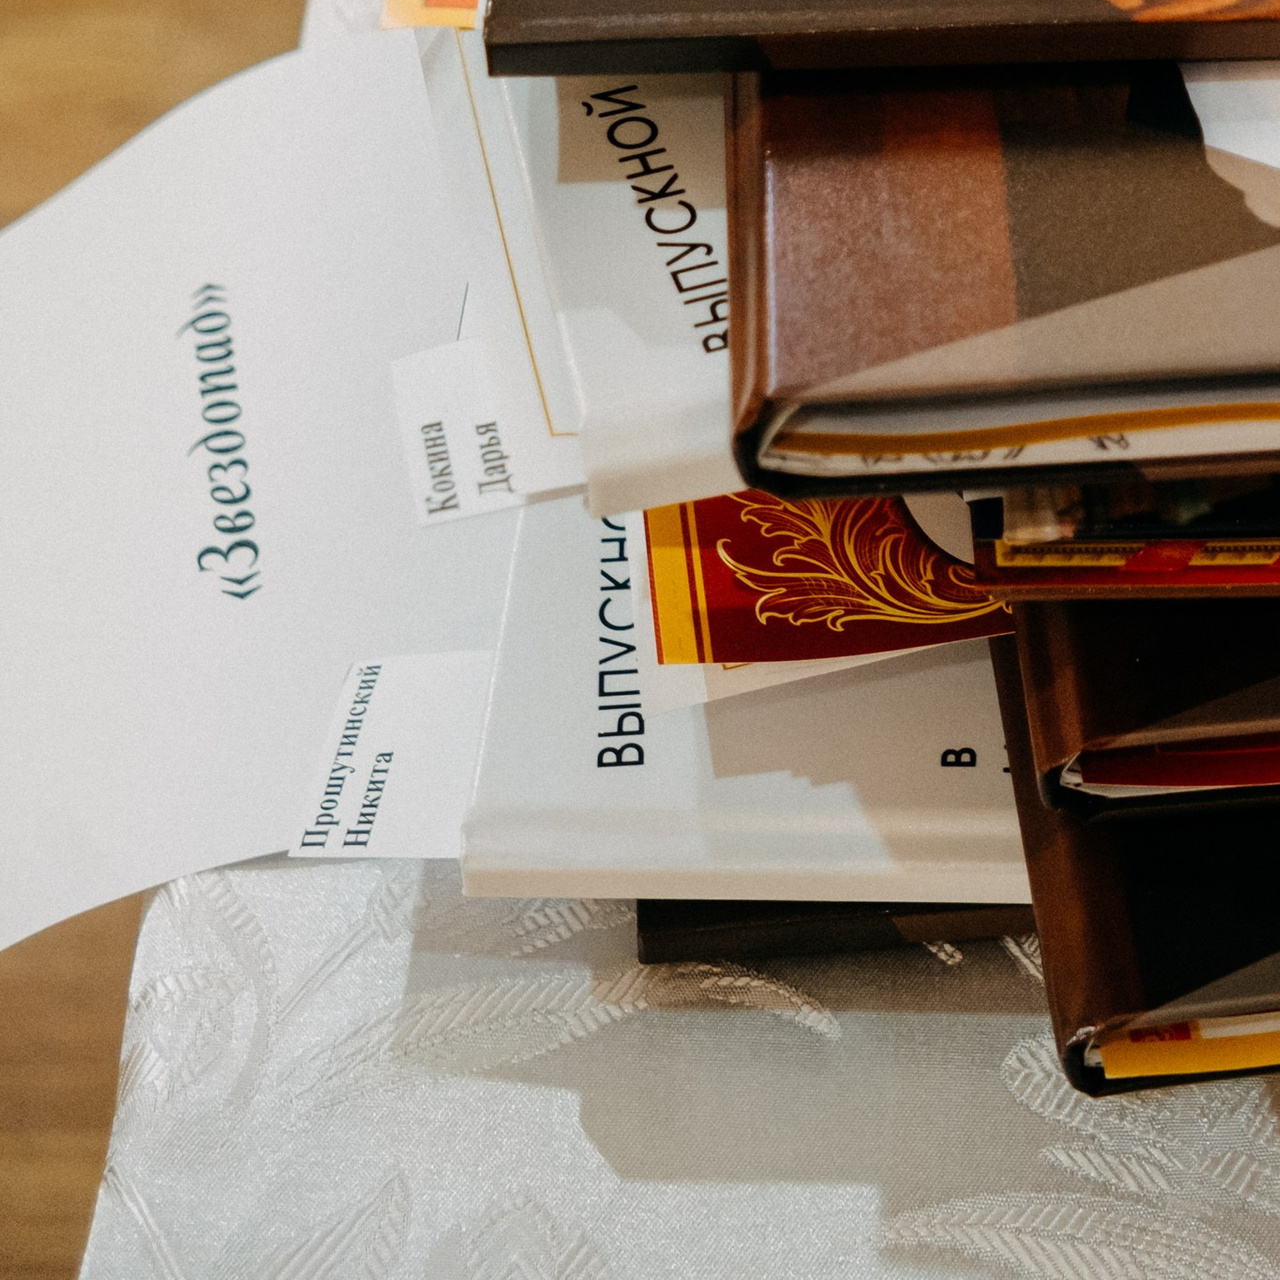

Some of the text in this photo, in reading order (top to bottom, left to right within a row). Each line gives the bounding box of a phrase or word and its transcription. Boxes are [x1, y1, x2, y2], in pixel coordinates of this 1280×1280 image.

[175, 282, 263, 600] «Звездопад»
[420, 421, 460, 516] Кокина
[475, 419, 516, 497] Дарья
[596, 515, 645, 768] ВЫПУСКН
[299, 663, 383, 849] Прошутинский
[342, 750, 394, 848] Никита
